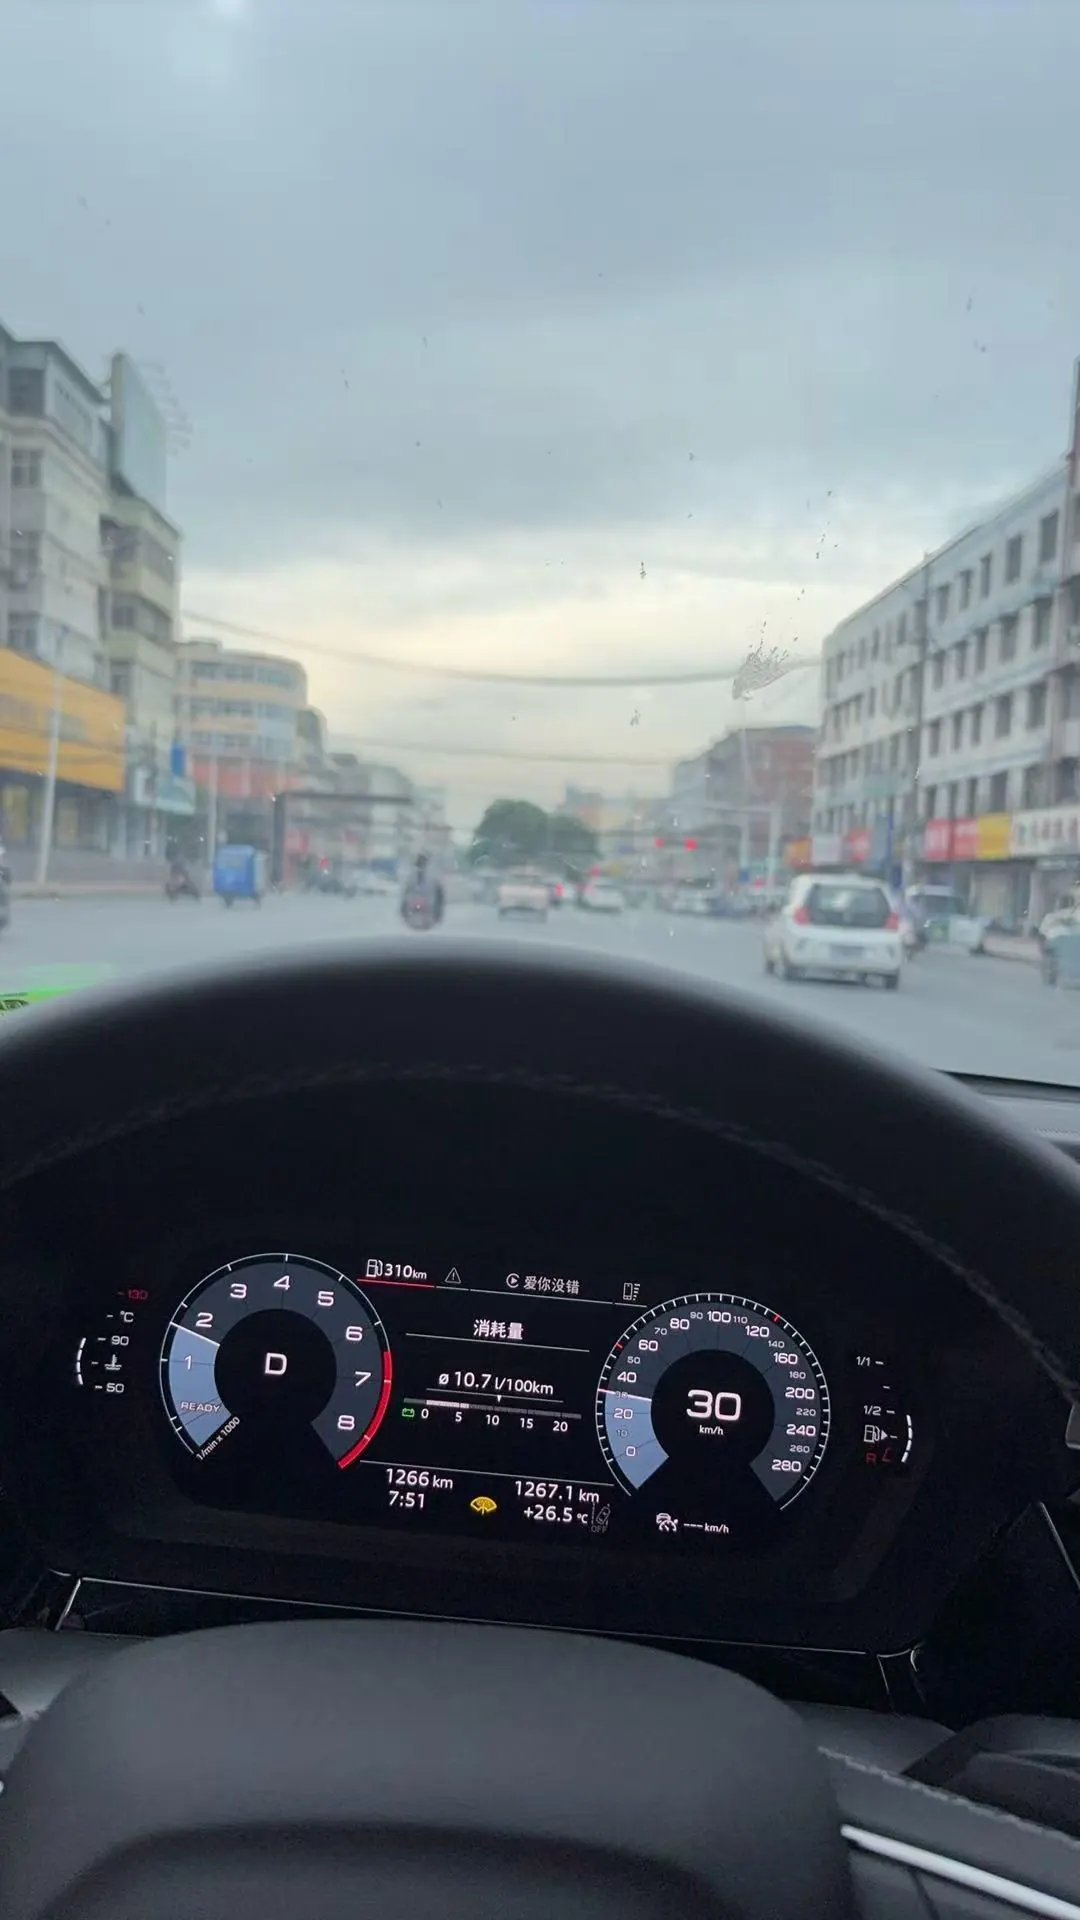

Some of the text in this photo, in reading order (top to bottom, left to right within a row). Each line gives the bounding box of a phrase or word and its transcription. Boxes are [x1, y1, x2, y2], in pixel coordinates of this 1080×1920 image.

[273, 1275, 291, 1290] 4
[524, 1276, 580, 1294] 爱你没错
[128, 1289, 148, 1299] 130
[230, 1283, 247, 1299] 3
[318, 1291, 334, 1306] 5
[196, 1312, 213, 1328] 2
[707, 1311, 731, 1323] 100
[670, 1318, 689, 1329] 80
[345, 1326, 363, 1341] 6
[474, 1320, 524, 1340] 消耗量
[654, 1327, 667, 1335] 70
[745, 1326, 770, 1337] 120
[111, 1335, 129, 1346] 90
[638, 1340, 658, 1351] 60
[768, 1340, 784, 1348] 140
[184, 1355, 192, 1370] 1
[265, 1353, 288, 1375] D
[627, 1356, 640, 1364] 50
[774, 1353, 798, 1364] 160
[856, 1356, 870, 1366] 1/1
[354, 1372, 371, 1387] 7
[454, 1371, 492, 1388] 10.7
[617, 1372, 636, 1383] 40
[106, 1382, 124, 1393] 50
[785, 1387, 815, 1399] 200
[181, 1401, 220, 1412] READY
[686, 1389, 741, 1421] 30
[864, 1405, 881, 1416] 1/2
[421, 1408, 429, 1419] 0
[455, 1412, 462, 1422] 5
[614, 1408, 633, 1419] 20
[796, 1408, 816, 1416] 220
[338, 1414, 355, 1430] 8
[486, 1415, 500, 1425] 10
[520, 1418, 533, 1429] 15
[552, 1421, 568, 1432] 20
[700, 1424, 723, 1436] km/h
[786, 1424, 816, 1436] 240
[196, 1440, 217, 1460] 1/min
[221, 1417, 240, 1436] 1000
[626, 1446, 635, 1456] 0
[790, 1445, 810, 1453] 260
[772, 1459, 801, 1472] 280
[386, 1468, 453, 1489] 1266 km
[516, 1481, 599, 1503] 1267.1 km
[388, 1491, 424, 1508] 7:51
[524, 1505, 572, 1522] +26.5
